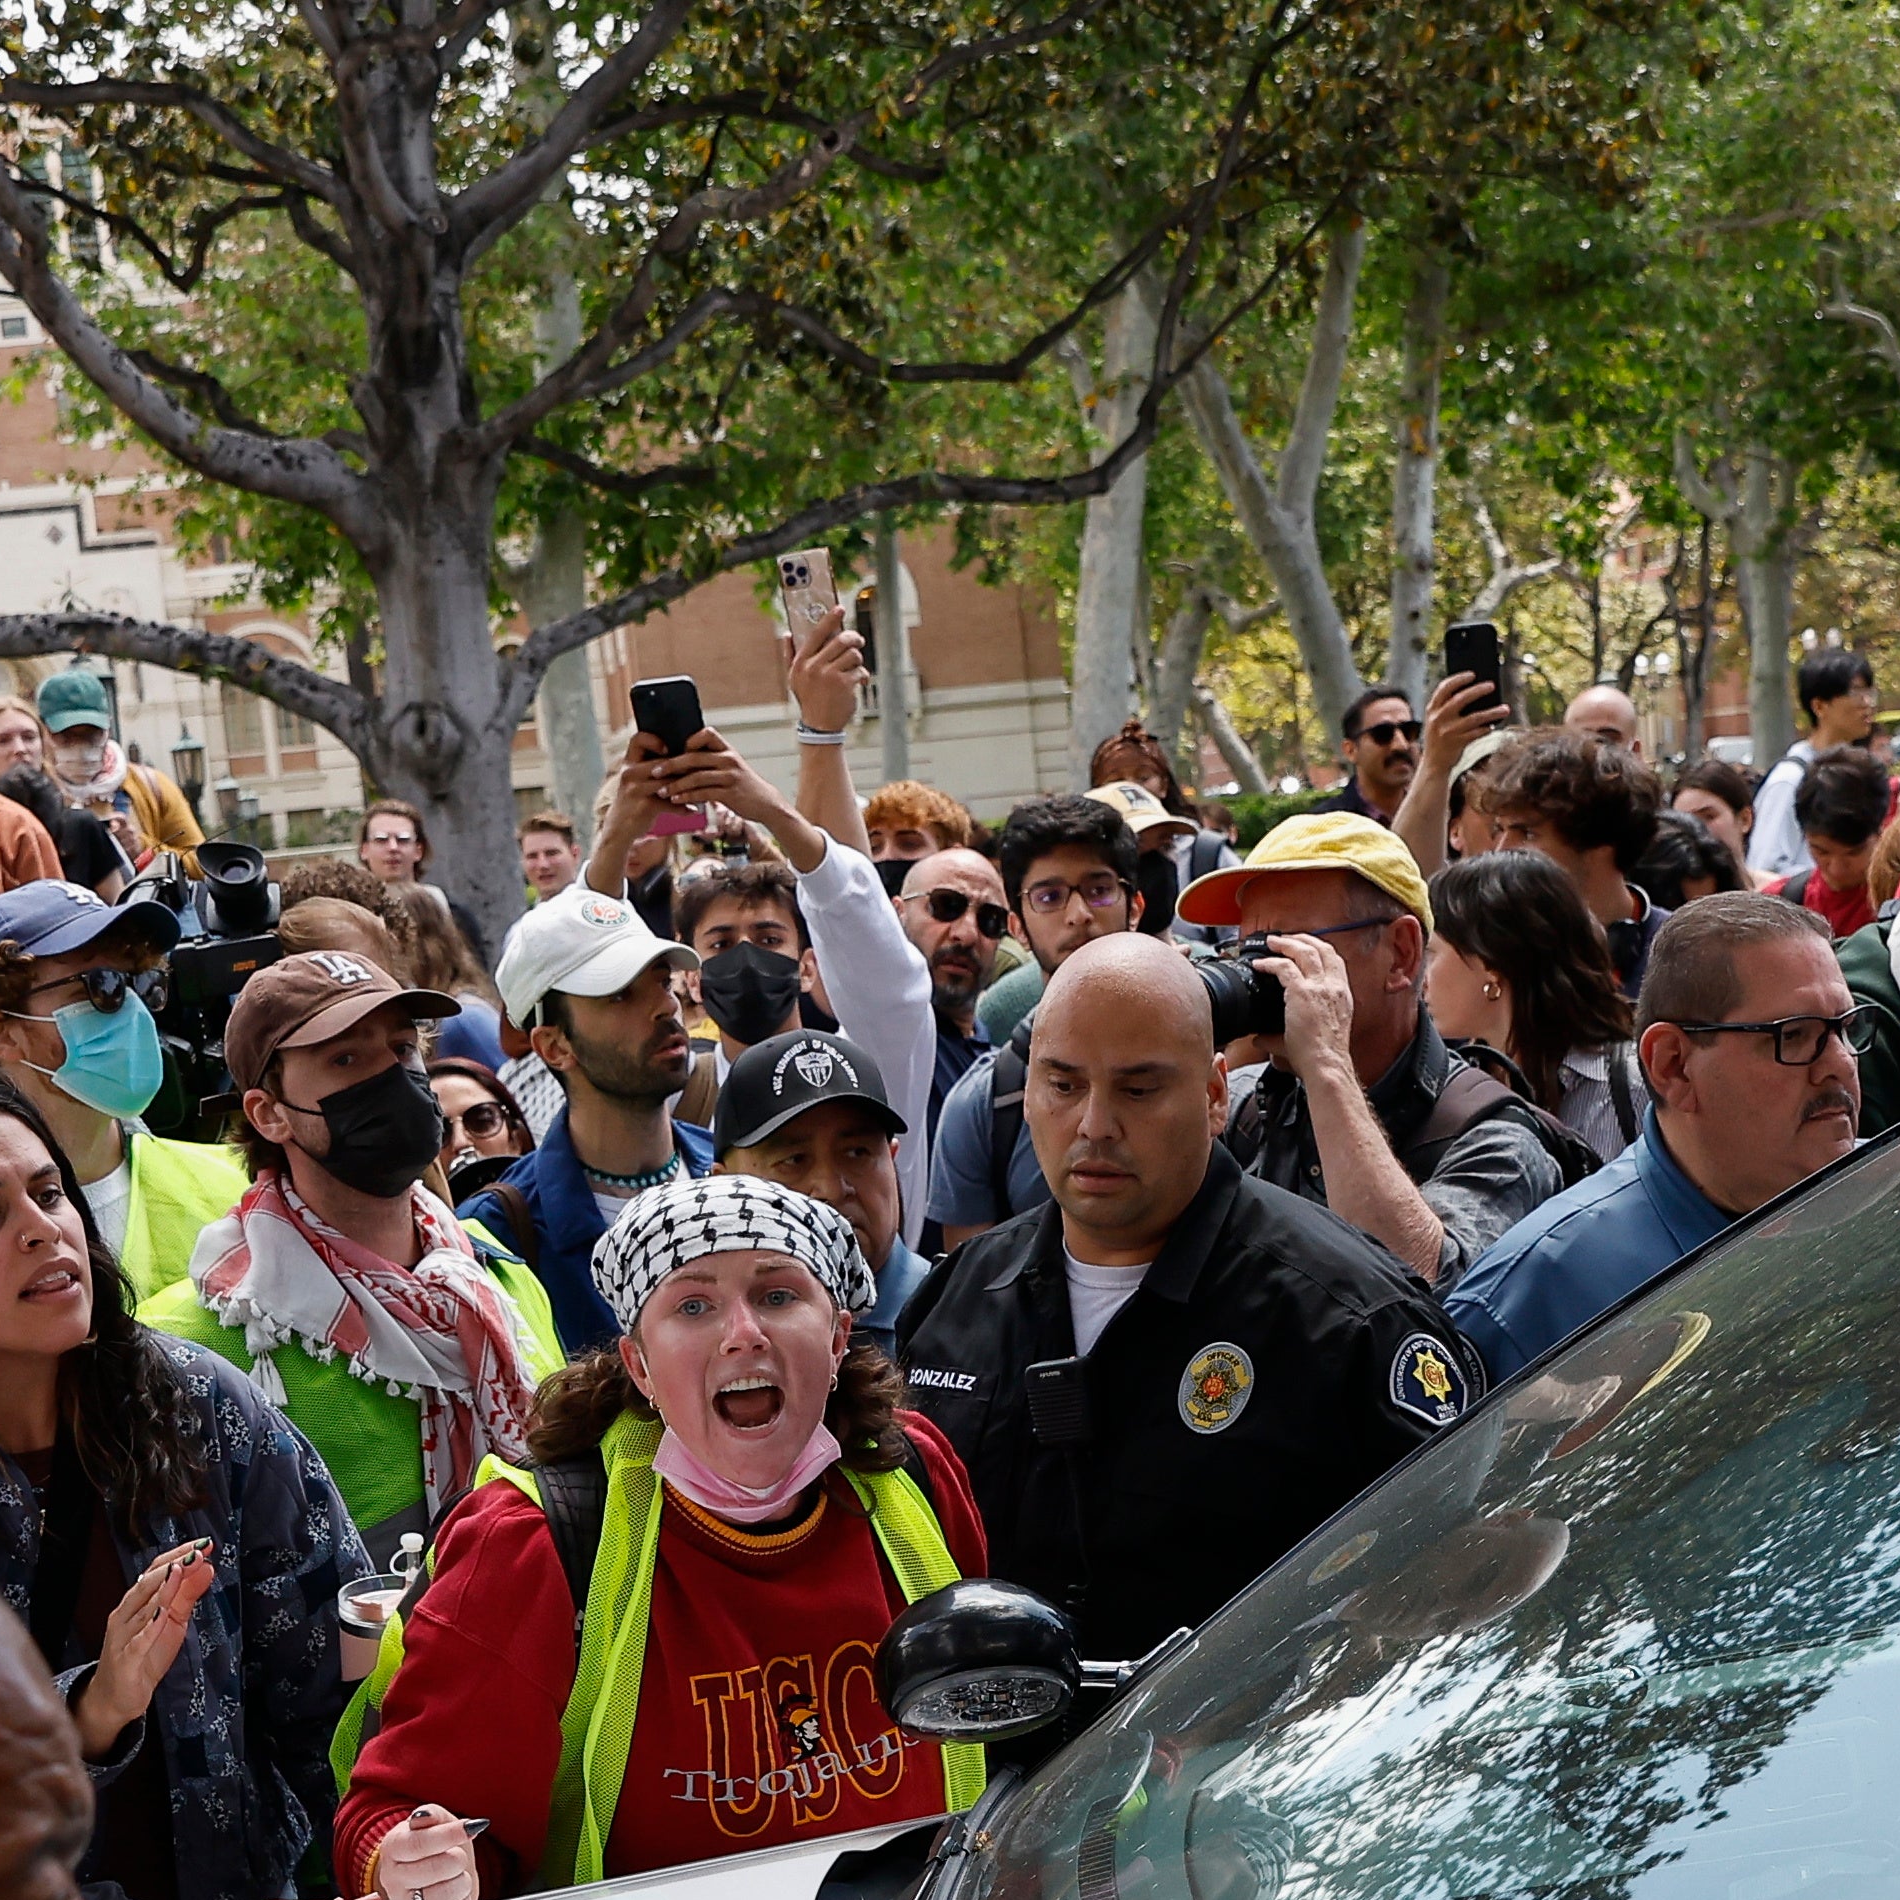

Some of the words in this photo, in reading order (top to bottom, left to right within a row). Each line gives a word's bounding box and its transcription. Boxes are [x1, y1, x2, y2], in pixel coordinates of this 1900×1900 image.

[308, 952, 374, 985] LA
[1207, 1351, 1240, 1367] OFFICER
[1396, 1356, 1408, 1400] UNIVERSITY
[689, 1640, 904, 1838] USC
